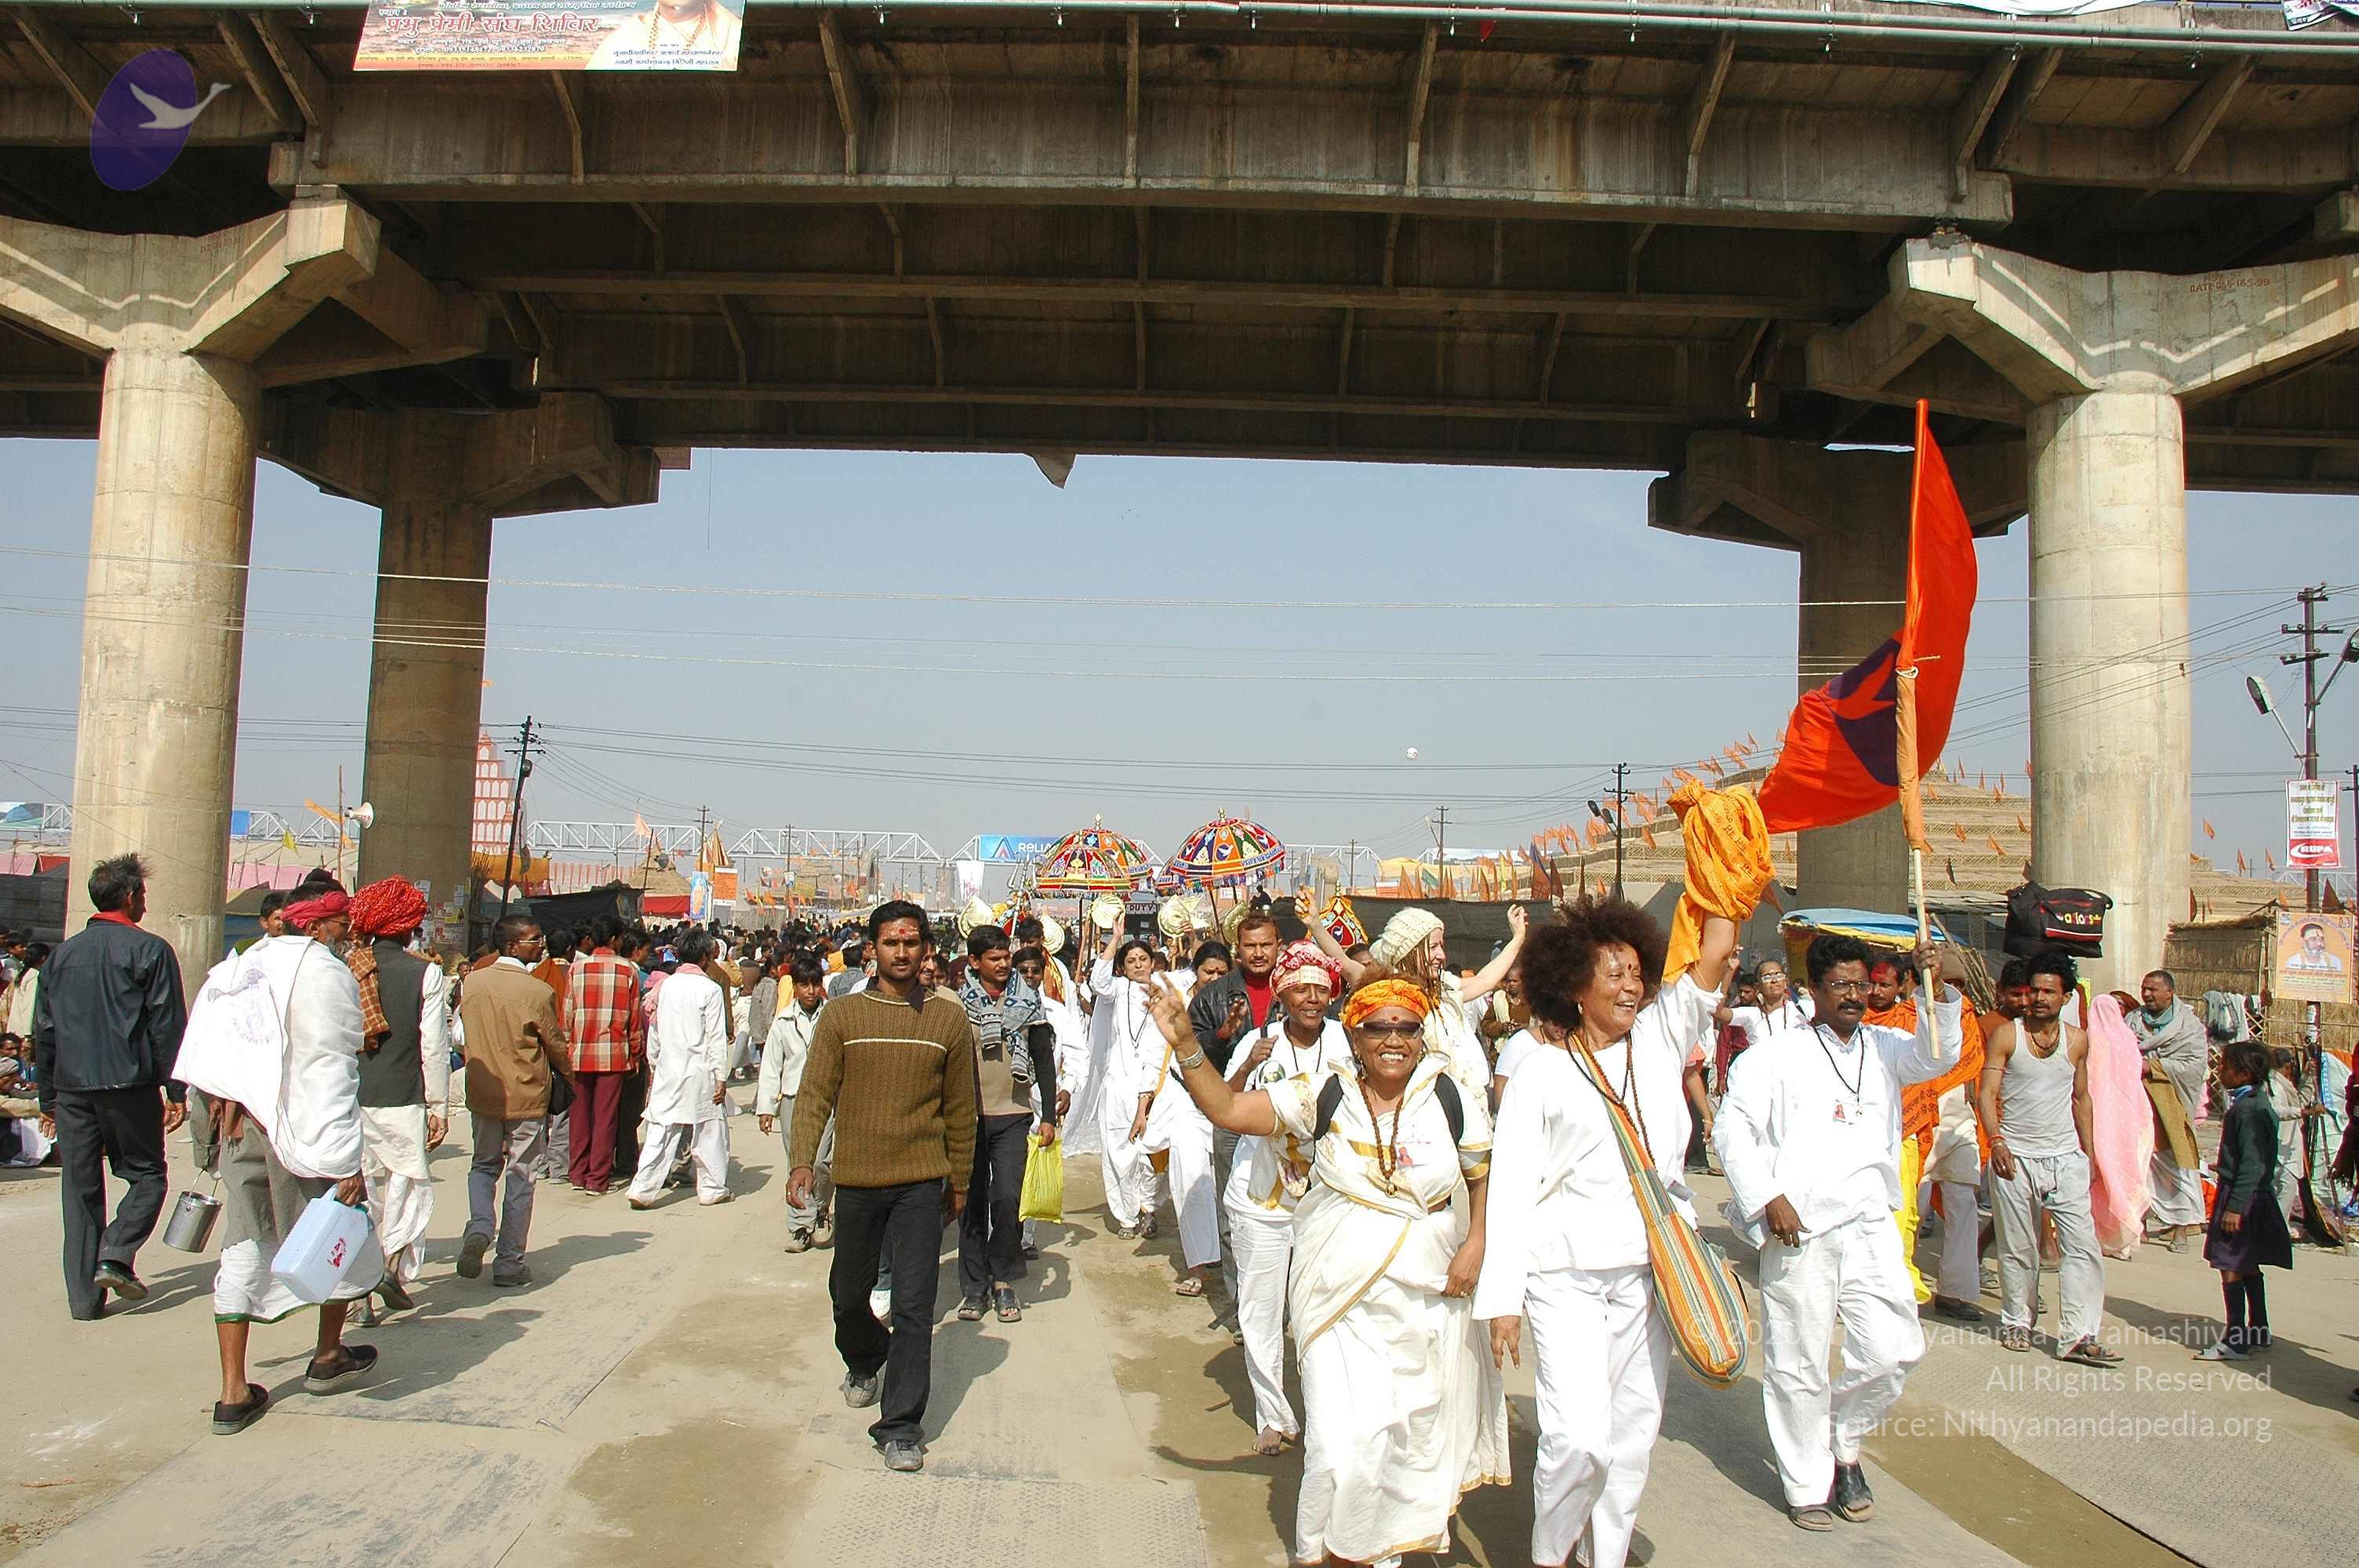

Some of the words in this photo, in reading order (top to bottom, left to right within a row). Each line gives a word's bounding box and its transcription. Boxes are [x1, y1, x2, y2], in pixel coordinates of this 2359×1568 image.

[385, 16, 422, 37] प्रभु
[429, 12, 475, 32] प्रेमी
[482, 13, 524, 33] संघ
[532, 11, 600, 32] शिविर
[2299, 844, 2334, 854] RUPA
